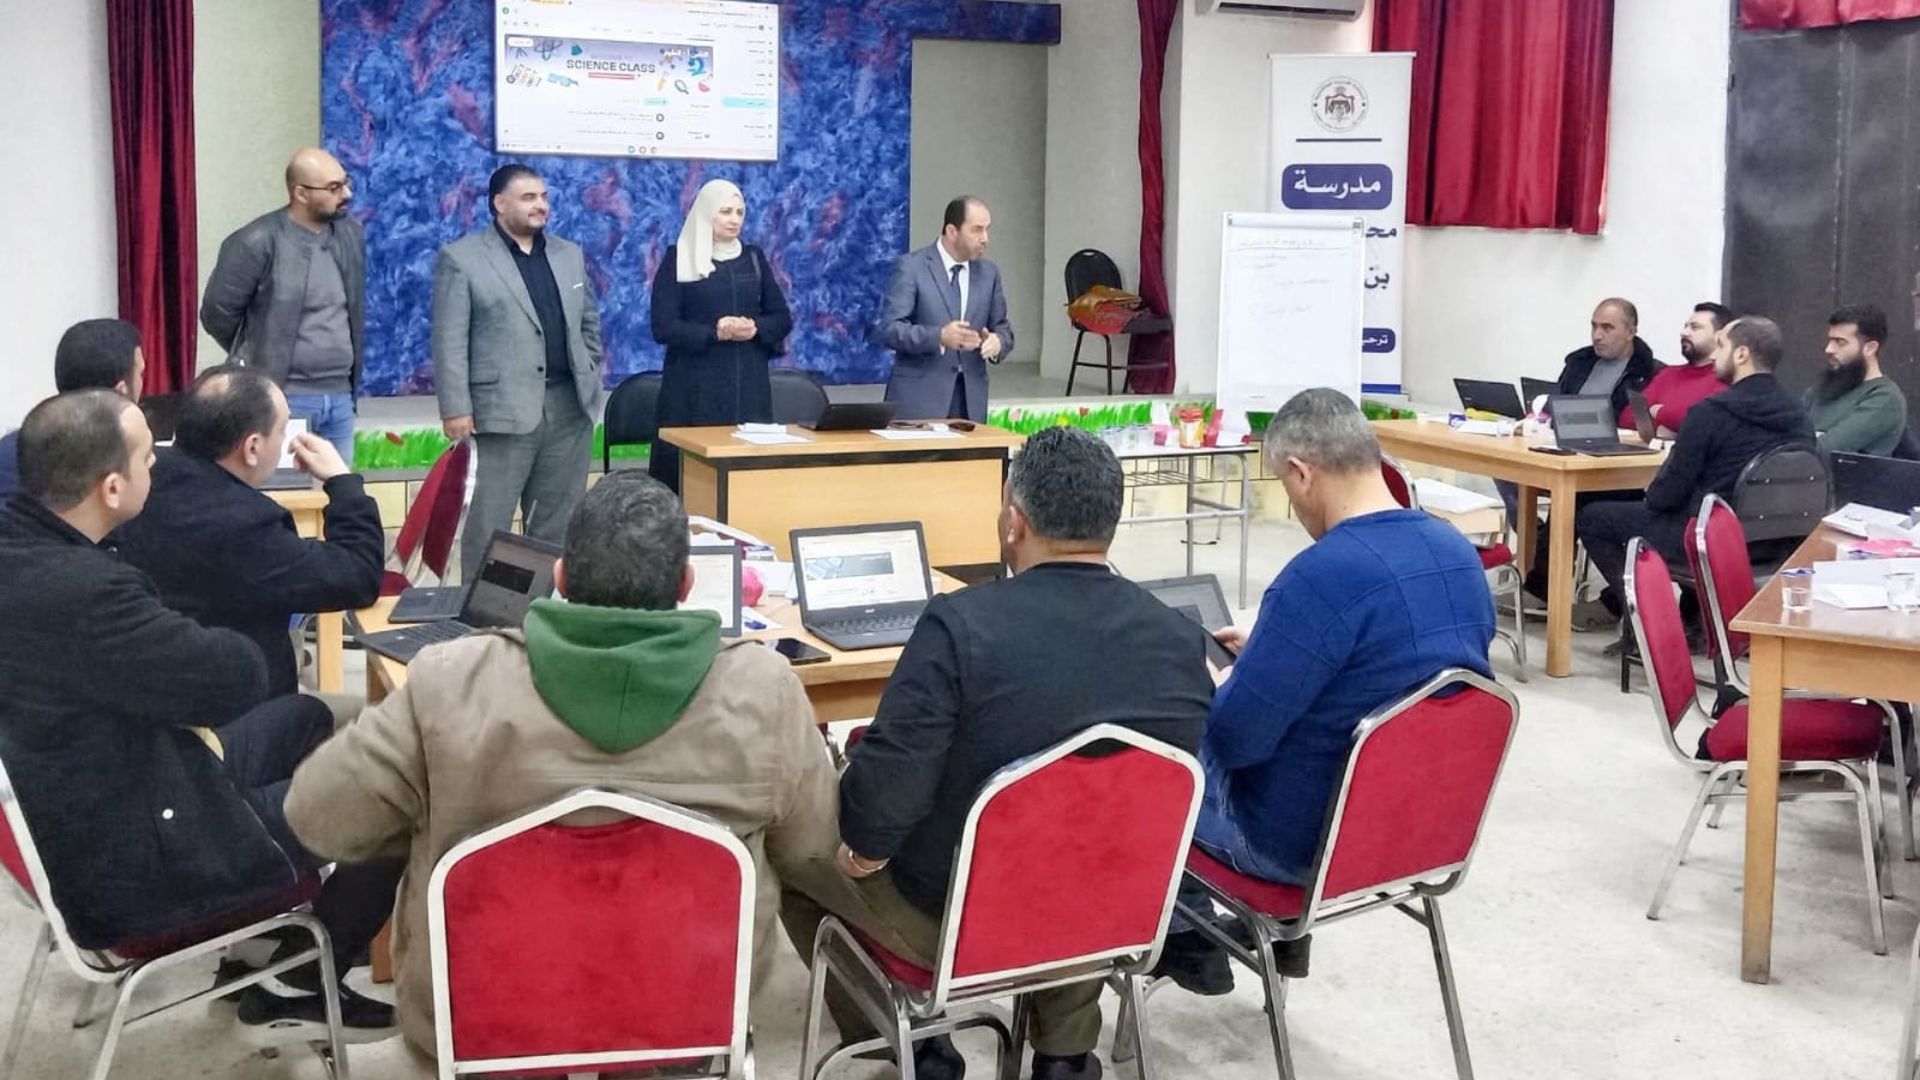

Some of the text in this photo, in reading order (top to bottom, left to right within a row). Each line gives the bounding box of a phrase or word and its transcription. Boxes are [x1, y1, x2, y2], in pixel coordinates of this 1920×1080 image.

[566, 59, 656, 73] SCIENCE CLASS
[1293, 168, 1382, 199] مدرسة
[1365, 227, 1397, 238] مح
